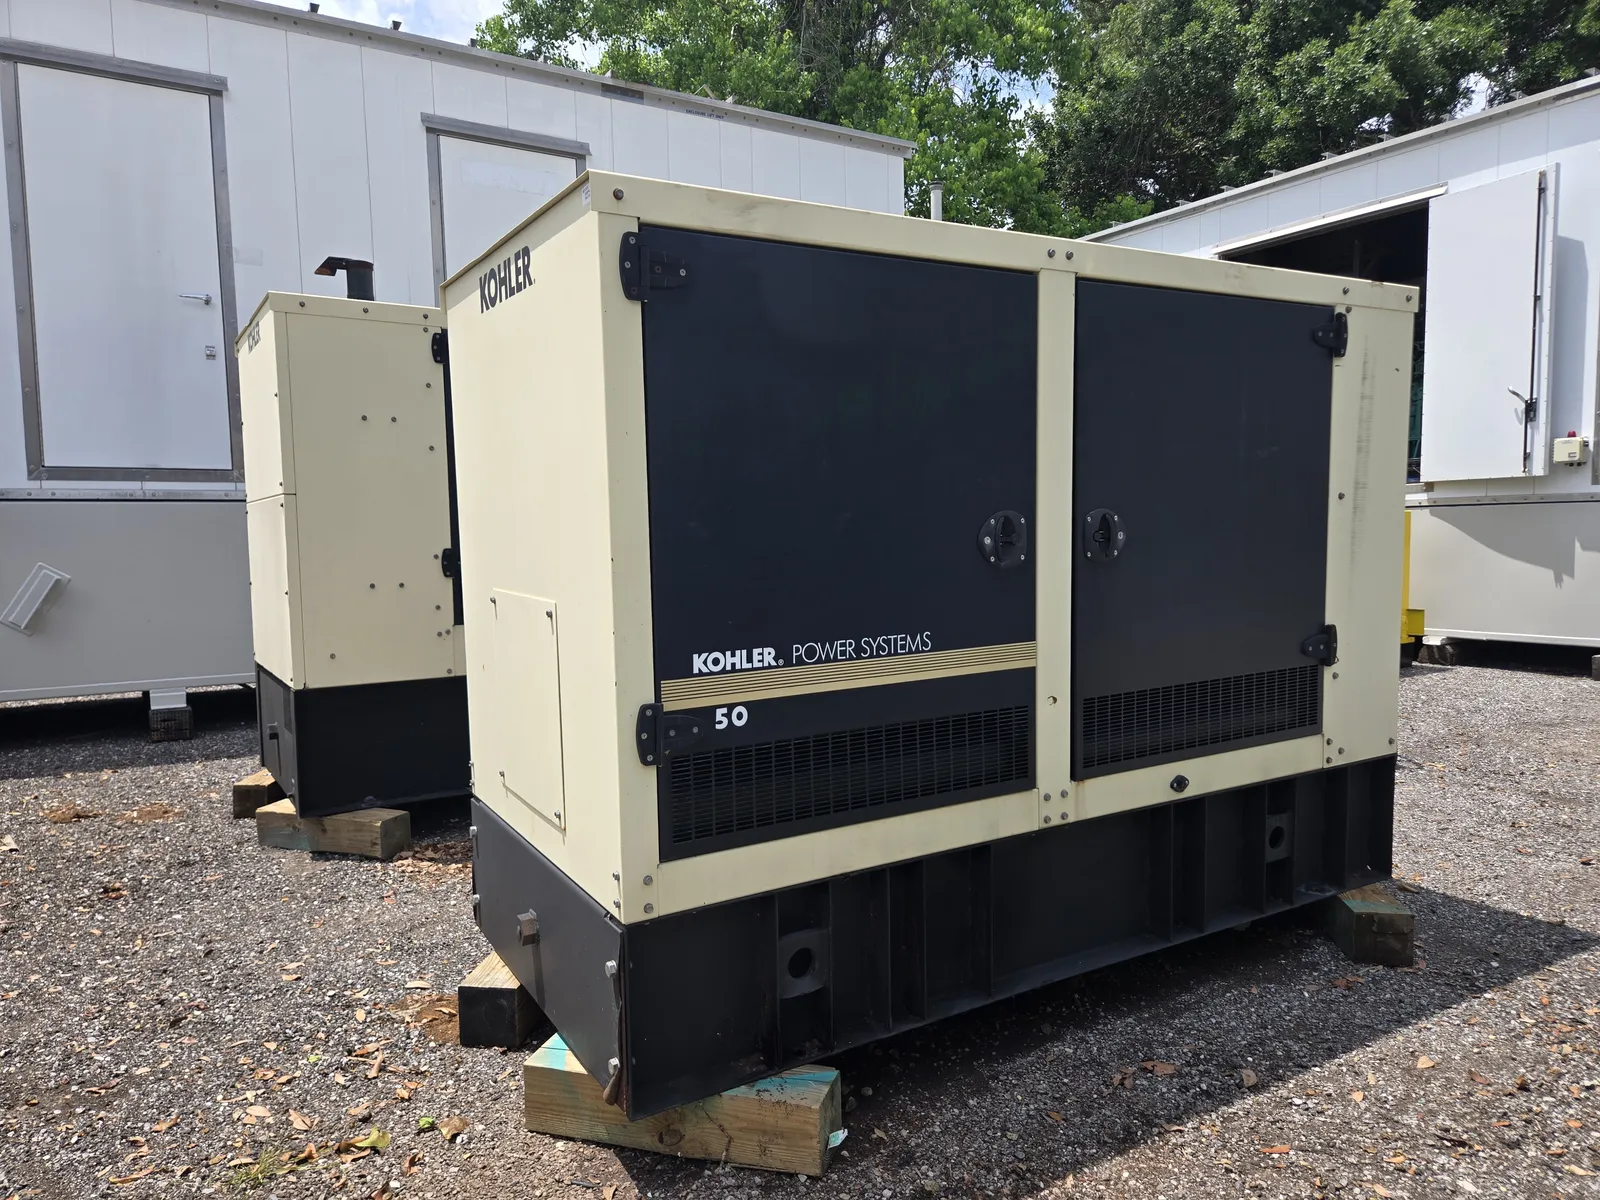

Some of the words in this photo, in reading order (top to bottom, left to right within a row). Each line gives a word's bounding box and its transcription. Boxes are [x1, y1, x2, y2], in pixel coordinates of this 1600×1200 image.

[793, 639, 856, 664] POWER
[861, 632, 932, 657] SYSTEMS
[715, 705, 748, 730] 50
